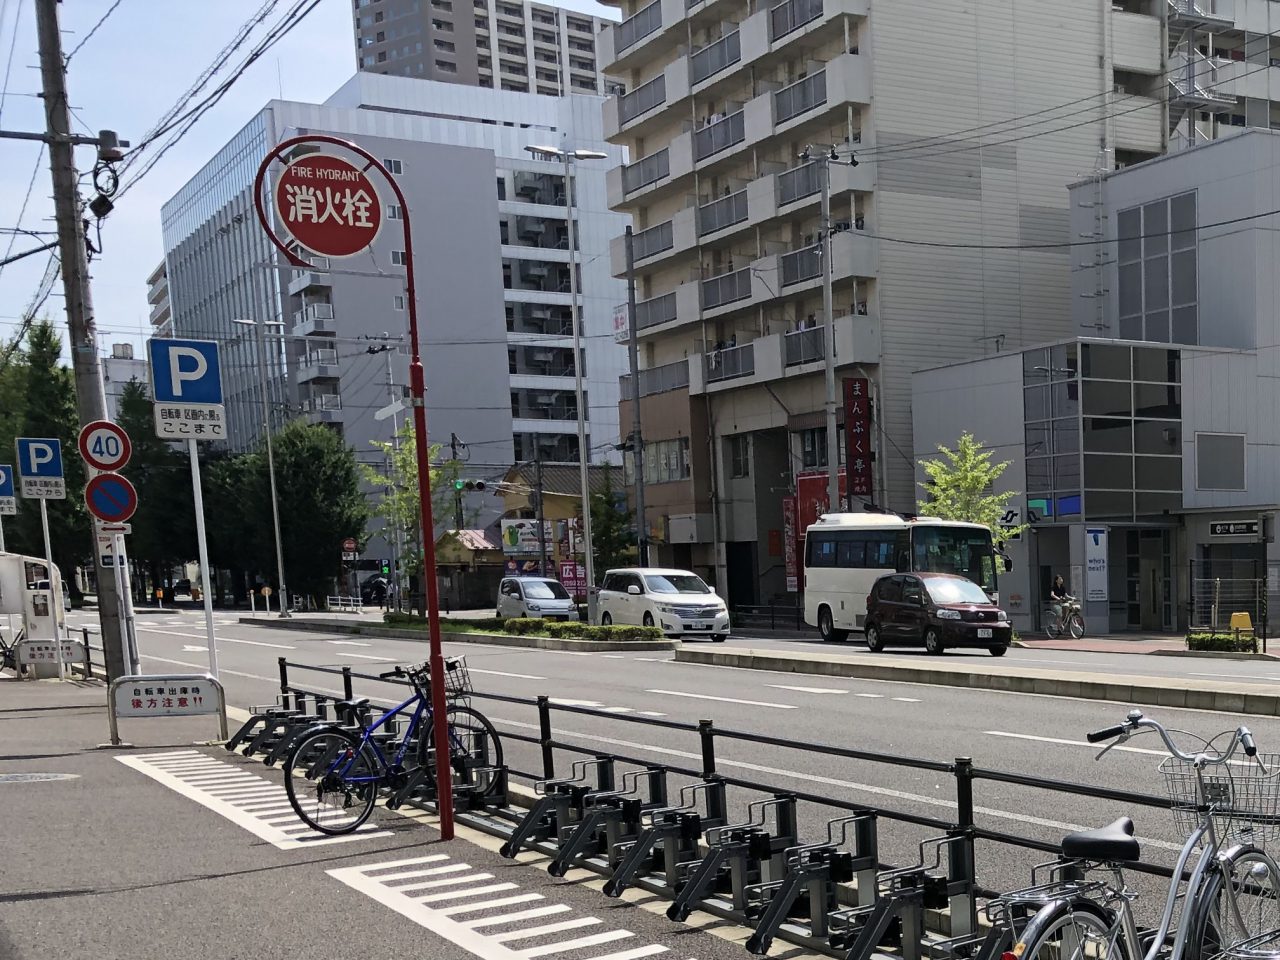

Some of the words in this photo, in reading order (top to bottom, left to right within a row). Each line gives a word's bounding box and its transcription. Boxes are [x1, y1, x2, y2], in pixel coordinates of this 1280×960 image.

[291, 166, 313, 178] FIRE
[316, 168, 360, 181] HYDRANT
[286, 184, 374, 228] 消火栓
[168, 346, 208, 396] P
[160, 408, 182, 420] 自転車
[163, 422, 222, 435] ここまで
[852, 382, 865, 472] まんぷく亭
[92, 436, 119, 458] 40
[29, 443, 54, 473] P
[26, 488, 63, 497] ここから
[562, 564, 585, 578] 広告
[133, 687, 200, 697] 自転車出庫時
